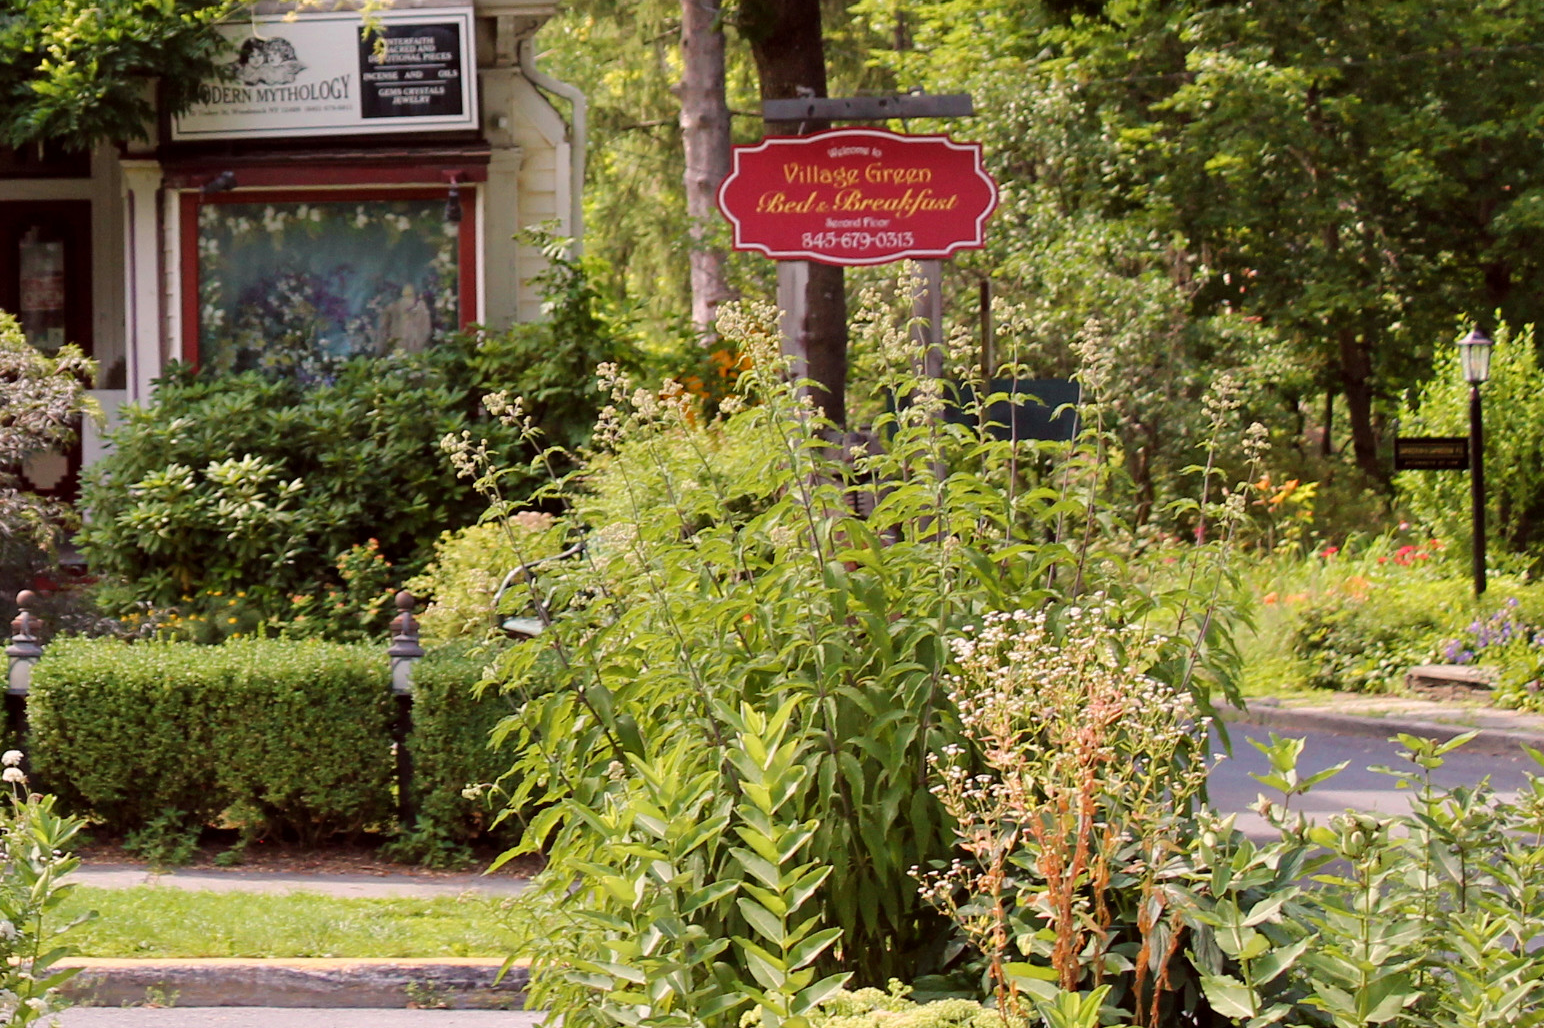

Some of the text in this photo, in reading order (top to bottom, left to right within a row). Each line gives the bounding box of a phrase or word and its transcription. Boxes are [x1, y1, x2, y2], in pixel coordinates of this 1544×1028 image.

[367, 53, 421, 63] DEOTIONAL
[404, 70, 423, 79] AND
[192, 74, 350, 105] ODERN MYTHOLOGY
[783, 162, 932, 188] Village Green
[756, 191, 818, 214] Bed
[832, 188, 959, 218] Breakfast
[802, 232, 915, 250] 845-679-0313
